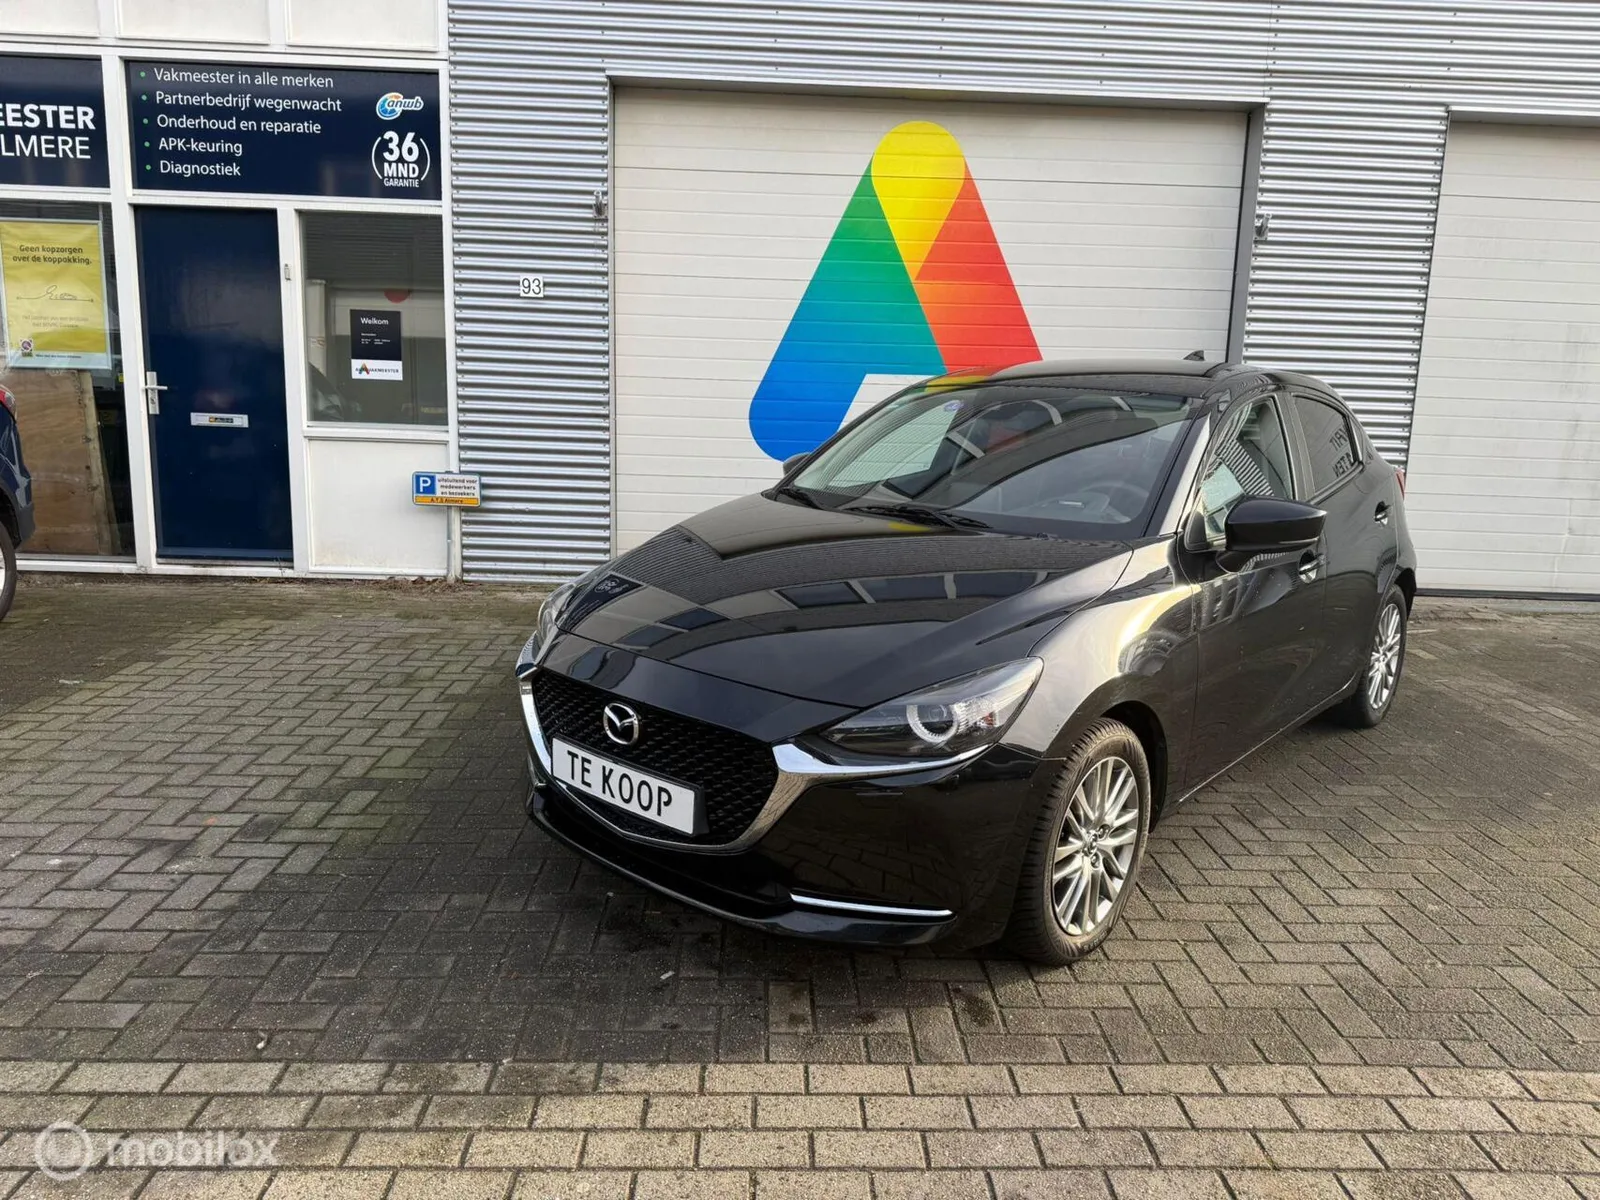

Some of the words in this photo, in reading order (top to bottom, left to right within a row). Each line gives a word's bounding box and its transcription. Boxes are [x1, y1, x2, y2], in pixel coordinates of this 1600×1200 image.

[154, 67, 235, 84] Vakmeester
[238, 71, 251, 84] in
[254, 71, 278, 86] alle
[281, 73, 334, 88] merken
[156, 90, 251, 111] Partnerbedrijf
[253, 97, 342, 112] wegenwacht
[386, 97, 423, 109] anwb
[157, 114, 236, 130] Onderhoud
[240, 120, 257, 131] en
[260, 120, 322, 135] reparatie
[0, 133, 91, 159] LMERE
[159, 137, 243, 157] APK-keuring
[382, 130, 420, 162] 36
[160, 160, 241, 178] Diagnostiek
[383, 162, 420, 178] MND
[383, 178, 420, 188] GARANTIE
[19, 244, 40, 253] Geen
[41, 245, 84, 255] kopzorgen
[31, 255, 42, 263] de
[521, 277, 542, 295] 93
[360, 317, 389, 325] Welkom
[419, 476, 431, 493] P
[567, 750, 592, 788] TE
[602, 765, 673, 816] KOOP
